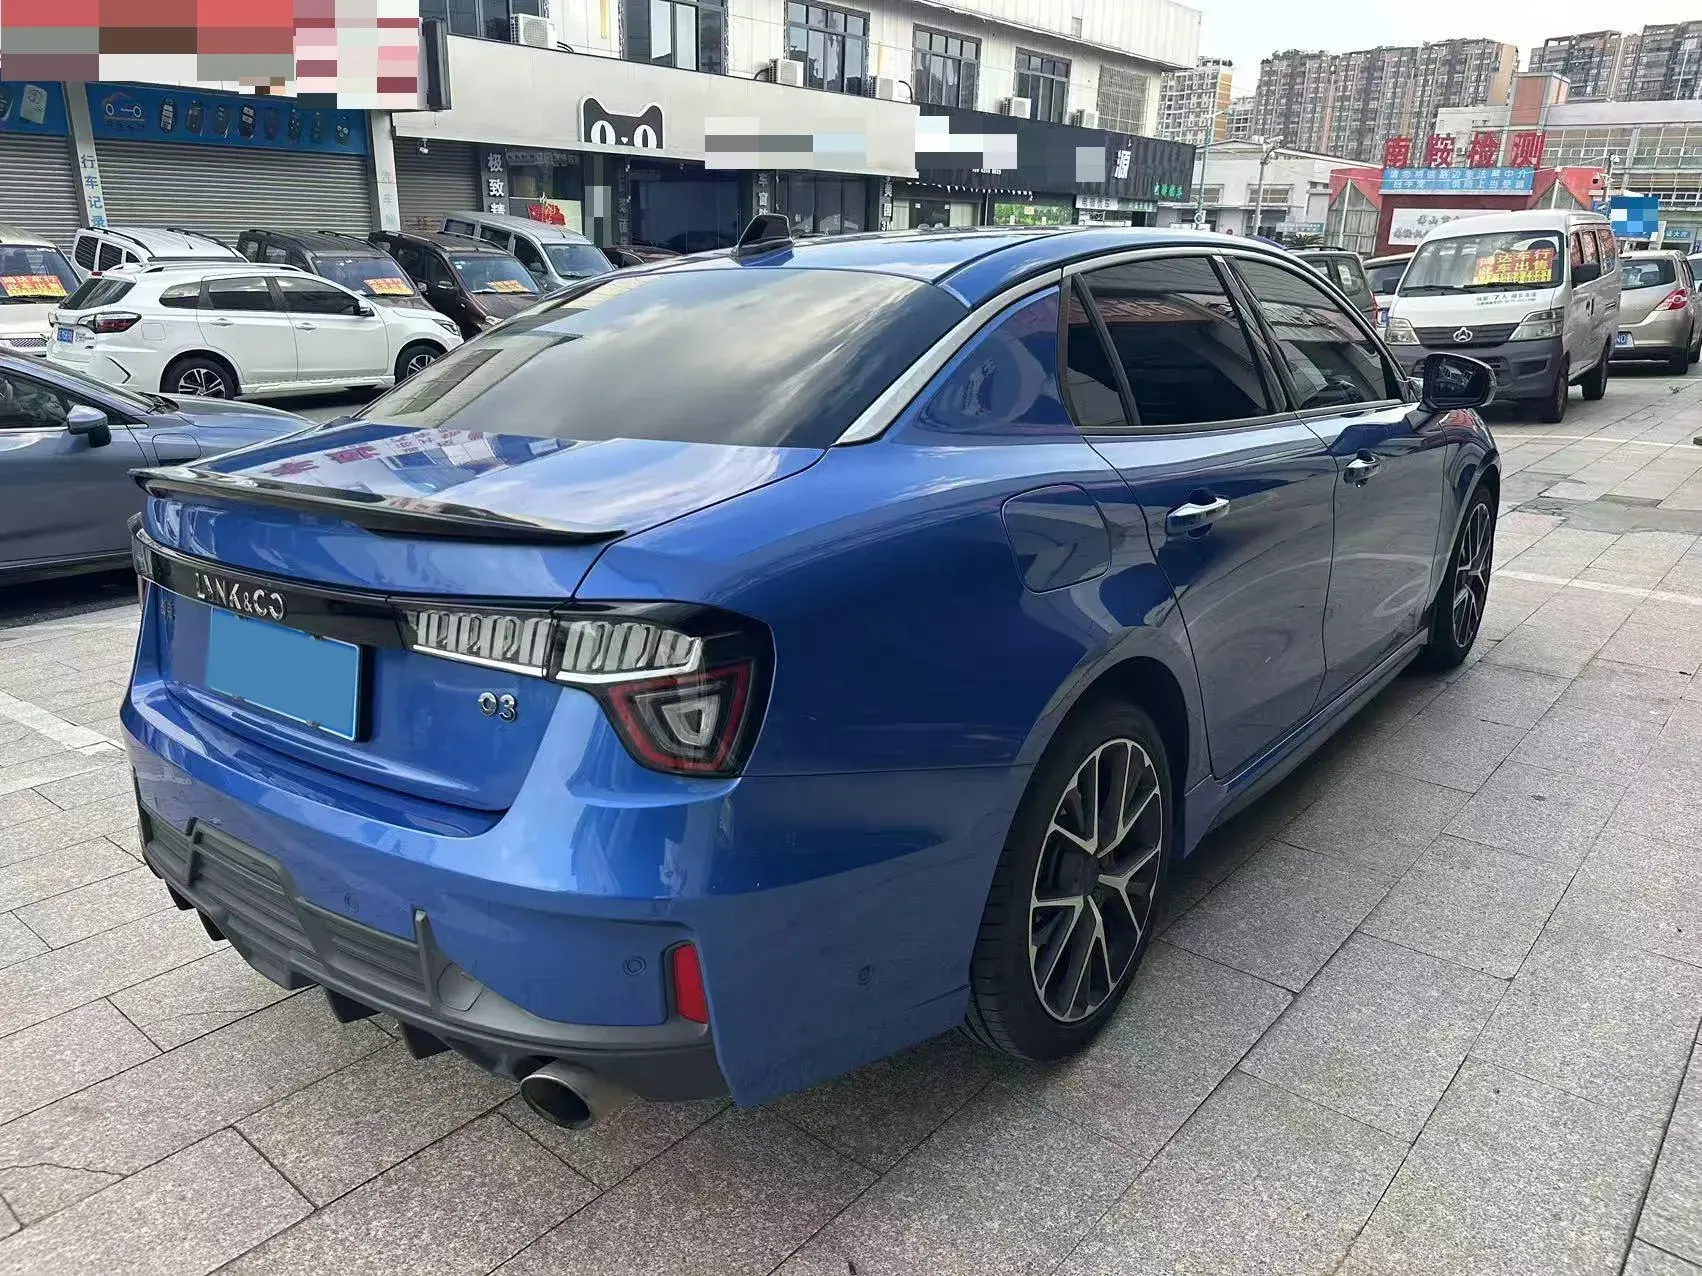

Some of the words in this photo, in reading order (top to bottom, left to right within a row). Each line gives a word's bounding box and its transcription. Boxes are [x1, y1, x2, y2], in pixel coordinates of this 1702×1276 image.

[81, 154, 106, 228] 行车记录
[195, 572, 285, 621] LYNK&CO
[478, 691, 516, 723] 03
